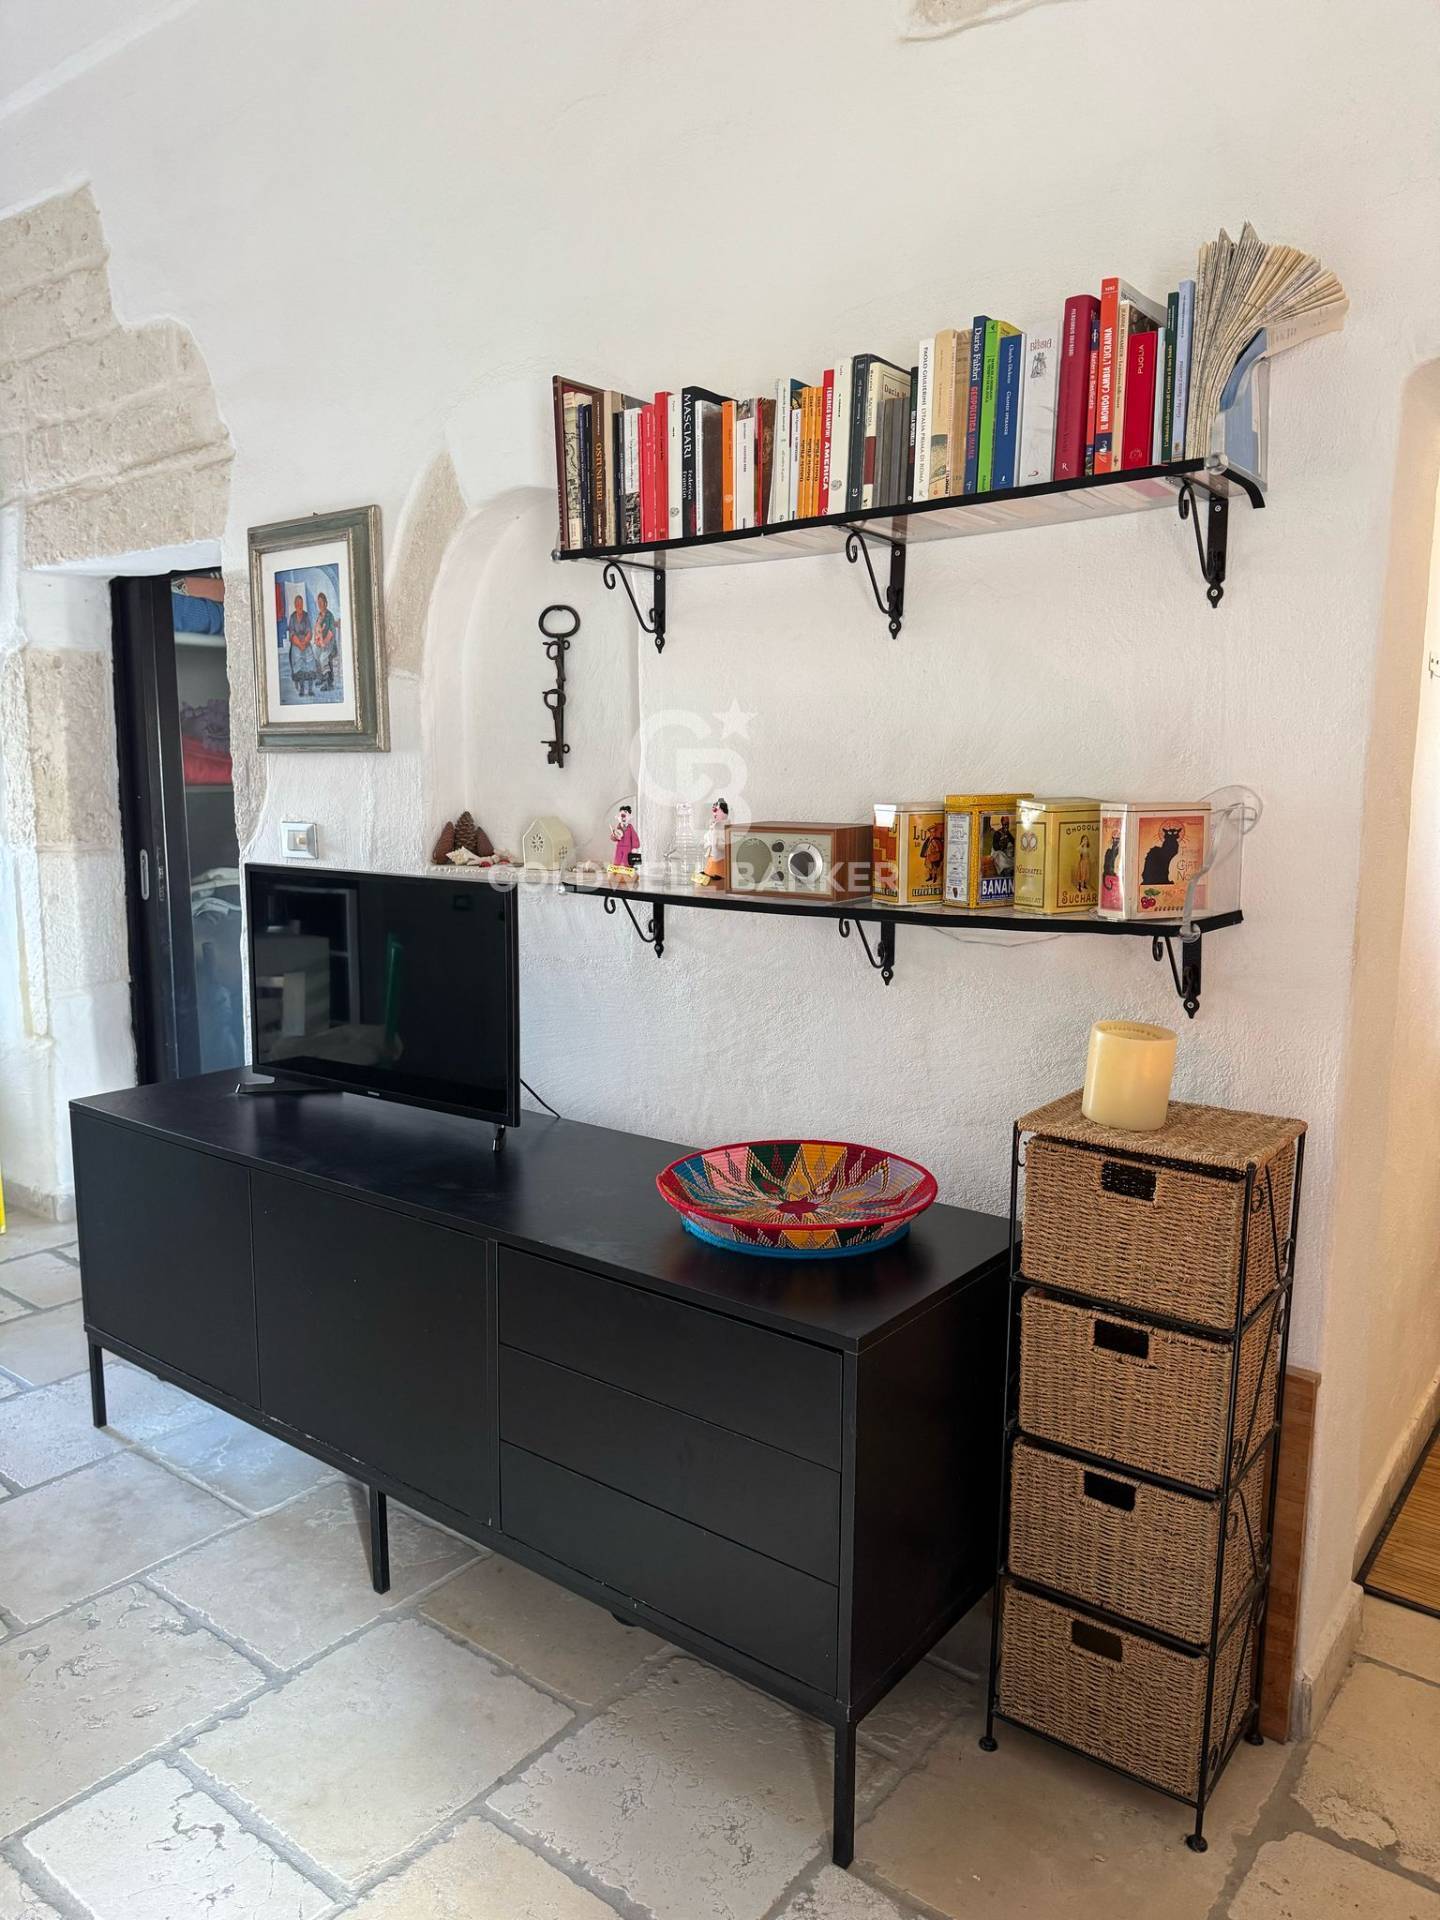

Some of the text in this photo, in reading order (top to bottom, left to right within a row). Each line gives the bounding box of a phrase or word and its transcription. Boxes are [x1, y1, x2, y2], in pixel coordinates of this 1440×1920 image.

[973, 327, 982, 352] Dario
[1103, 327, 1112, 364] L'UCRAINA
[971, 353, 981, 381] Fabbri
[1137, 344, 1145, 374] PUGLIA
[1102, 367, 1111, 392] CAMBIA
[968, 386, 978, 433] GEOPOLITICA
[1101, 395, 1109, 422] MONDO
[683, 394, 692, 459] MASCIARI
[822, 441, 831, 491] AMERICA
[1066, 824, 1099, 835] CHOCOLA
[982, 879, 1015, 896] BANAN
[1061, 891, 1097, 905] SUCHAR
